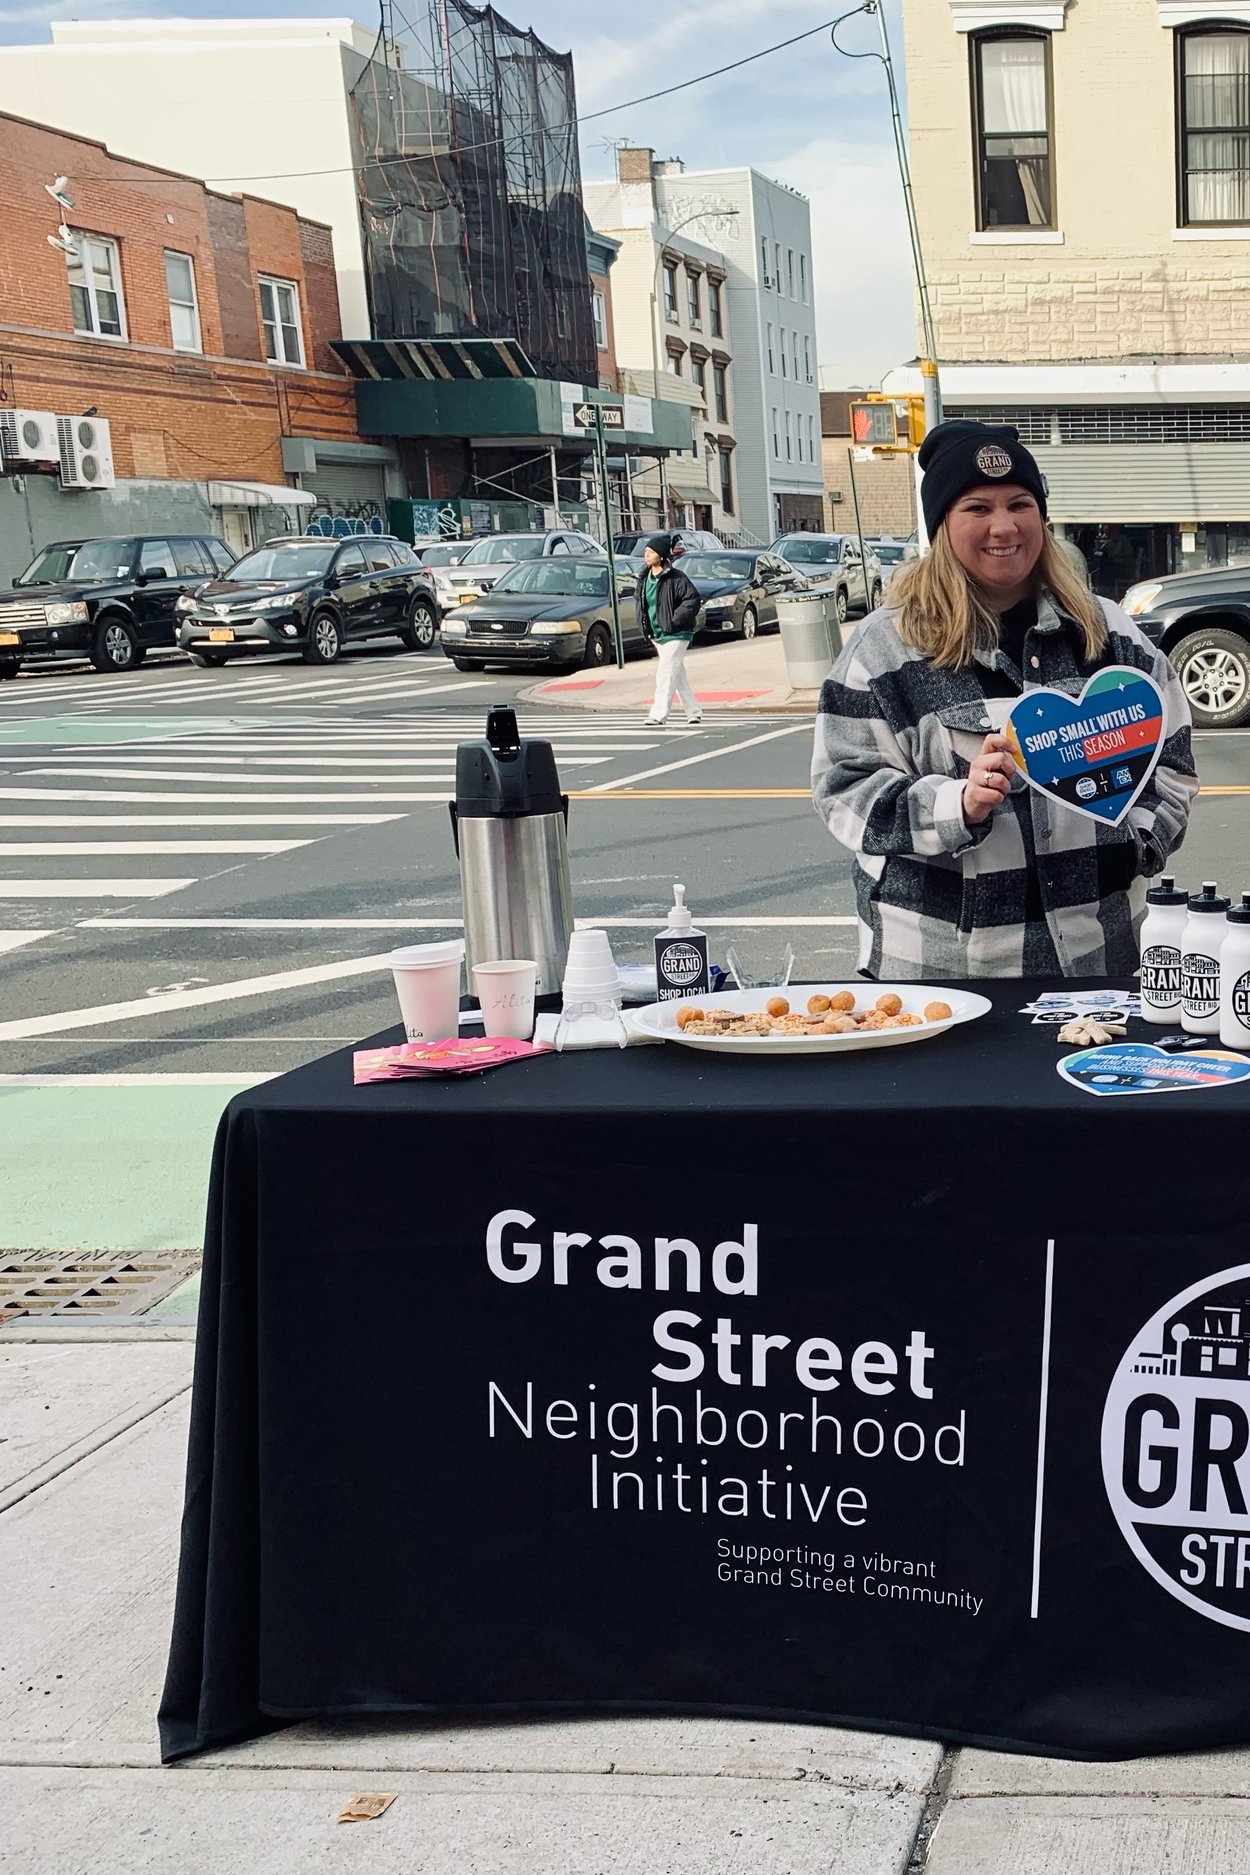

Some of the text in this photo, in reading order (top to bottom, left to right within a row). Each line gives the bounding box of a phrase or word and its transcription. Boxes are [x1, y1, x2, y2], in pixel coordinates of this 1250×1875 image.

[580, 410, 618, 422] ONE WAY
[977, 455, 1013, 469] GRAND
[1024, 703, 1146, 753] SHOP SMALL WITH US
[1057, 730, 1127, 764] THIS SEASON
[663, 957, 700, 973] GRAND
[1141, 967, 1181, 990] GRAN
[659, 988, 682, 1001] SHOP
[1147, 989, 1173, 1002] STREET
[1184, 999, 1218, 1012] STREET BID
[1150, 1057, 1198, 1067] HOLIDAY
[1196, 1062, 1233, 1073] CHEER
[485, 1208, 759, 1296] Grand
[650, 1309, 935, 1400] Street
[488, 1380, 967, 1467] Neighborhood
[590, 1453, 869, 1527] Initiative
[717, 1537, 938, 1579] Supporting a vibrant
[717, 1562, 985, 1617] Grand Street Community
